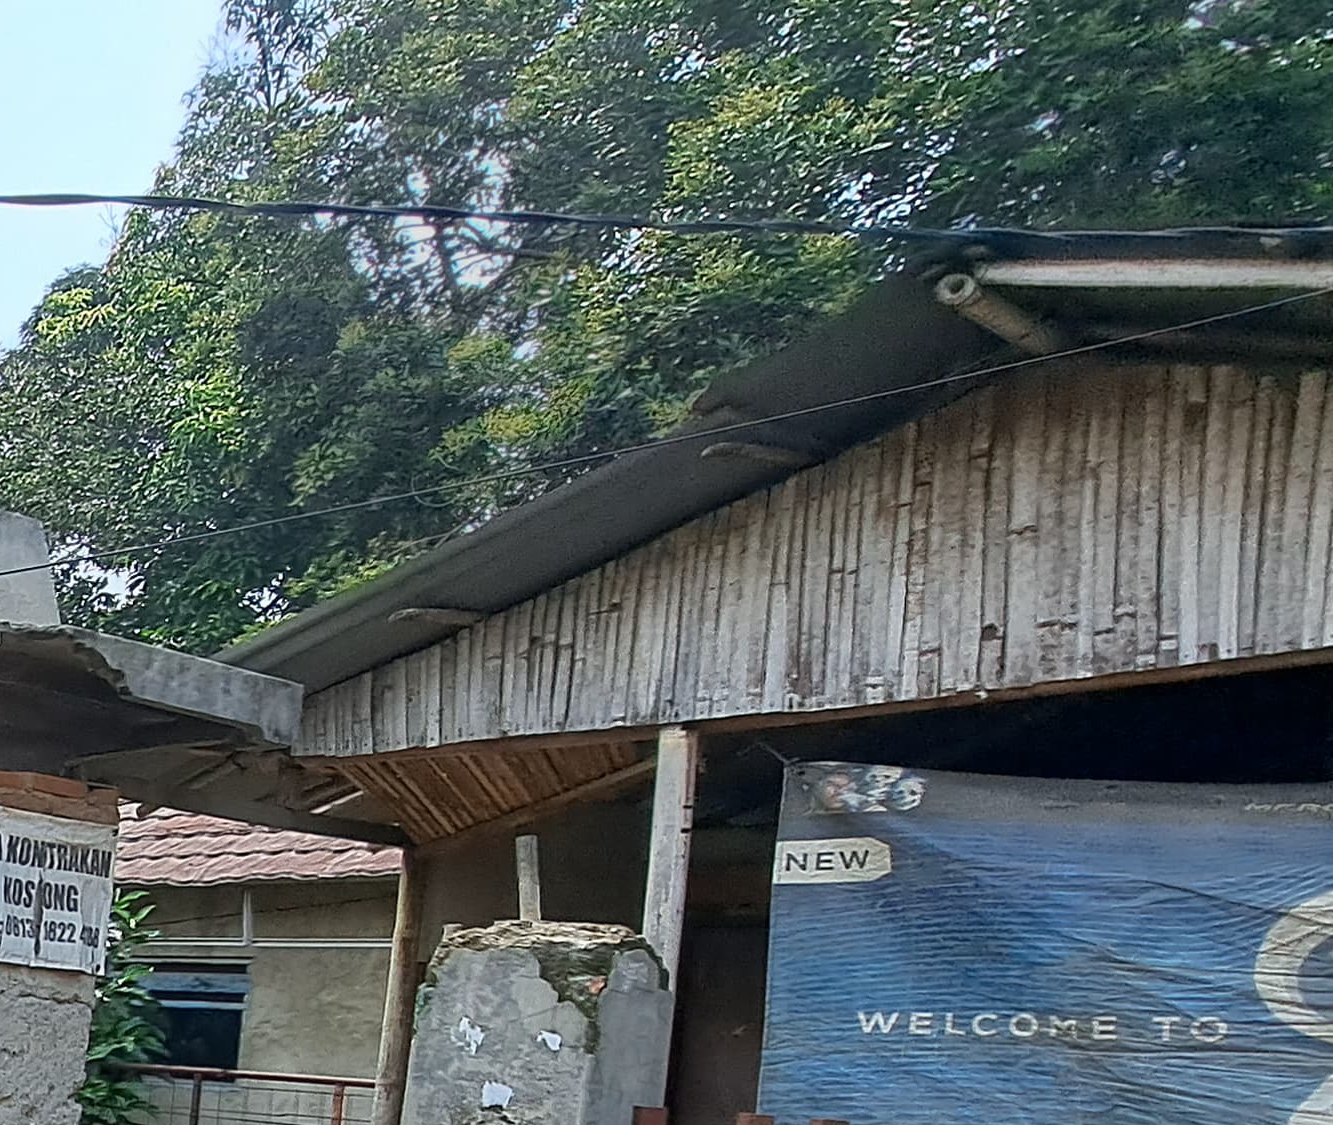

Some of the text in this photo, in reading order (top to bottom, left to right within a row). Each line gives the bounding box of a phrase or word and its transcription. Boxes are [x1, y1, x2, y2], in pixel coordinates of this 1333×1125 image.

[5, 835, 113, 878] KONTRAKAN
[785, 849, 870, 872] NEW
[857, 1010, 1228, 1043] WELCOME TO
